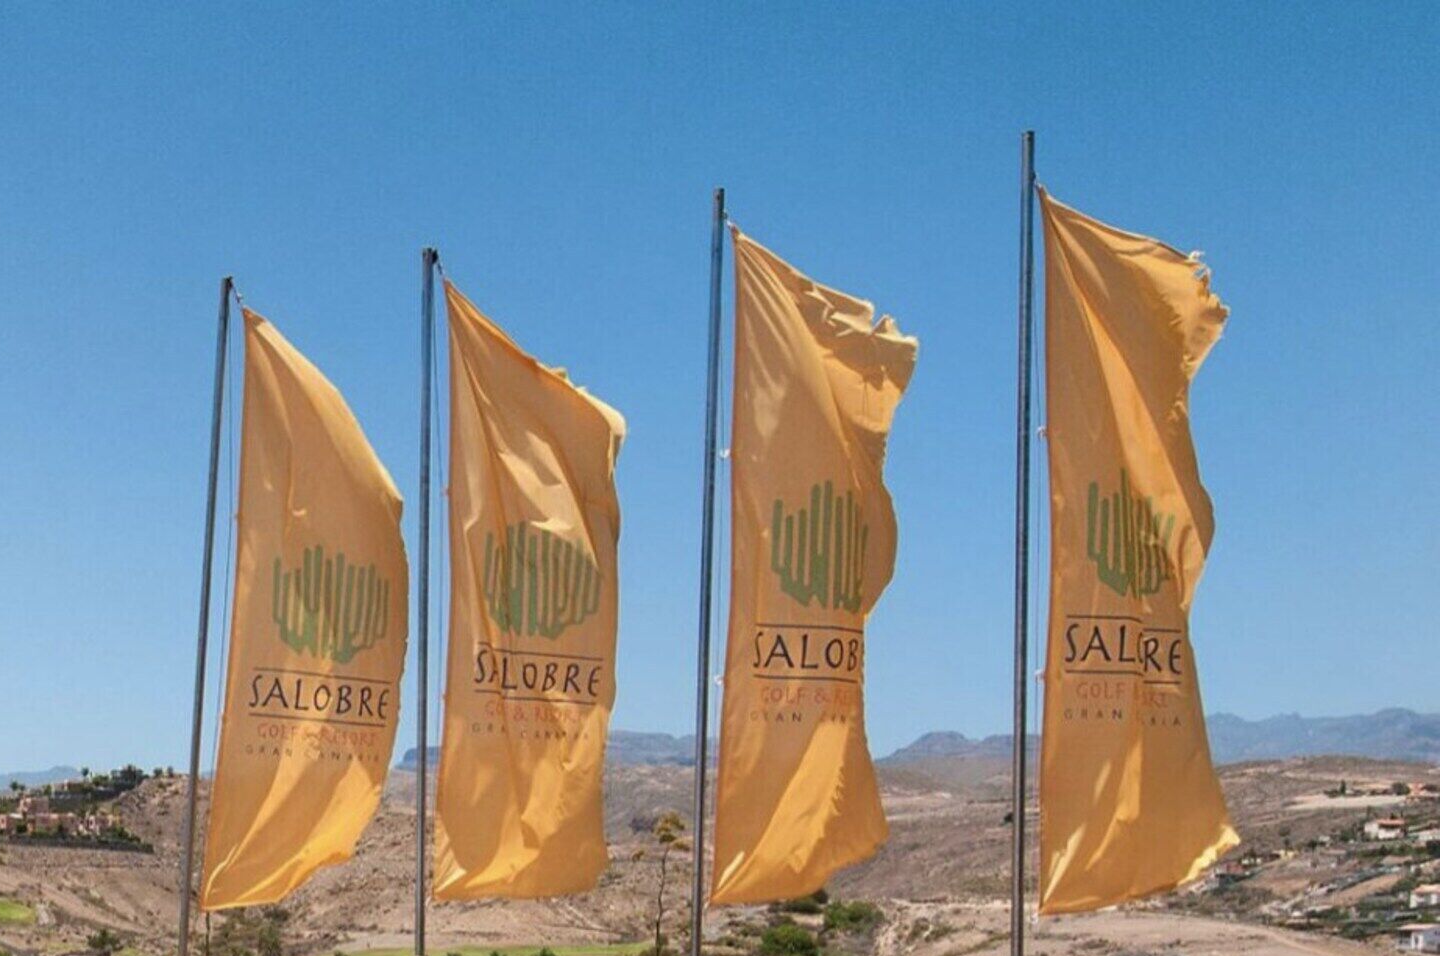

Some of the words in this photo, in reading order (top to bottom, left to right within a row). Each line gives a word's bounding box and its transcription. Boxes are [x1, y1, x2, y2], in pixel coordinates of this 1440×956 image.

[753, 632, 859, 672] SALOB
[249, 675, 390, 719] SALOBRE
[1076, 681, 1125, 699] GOLF
